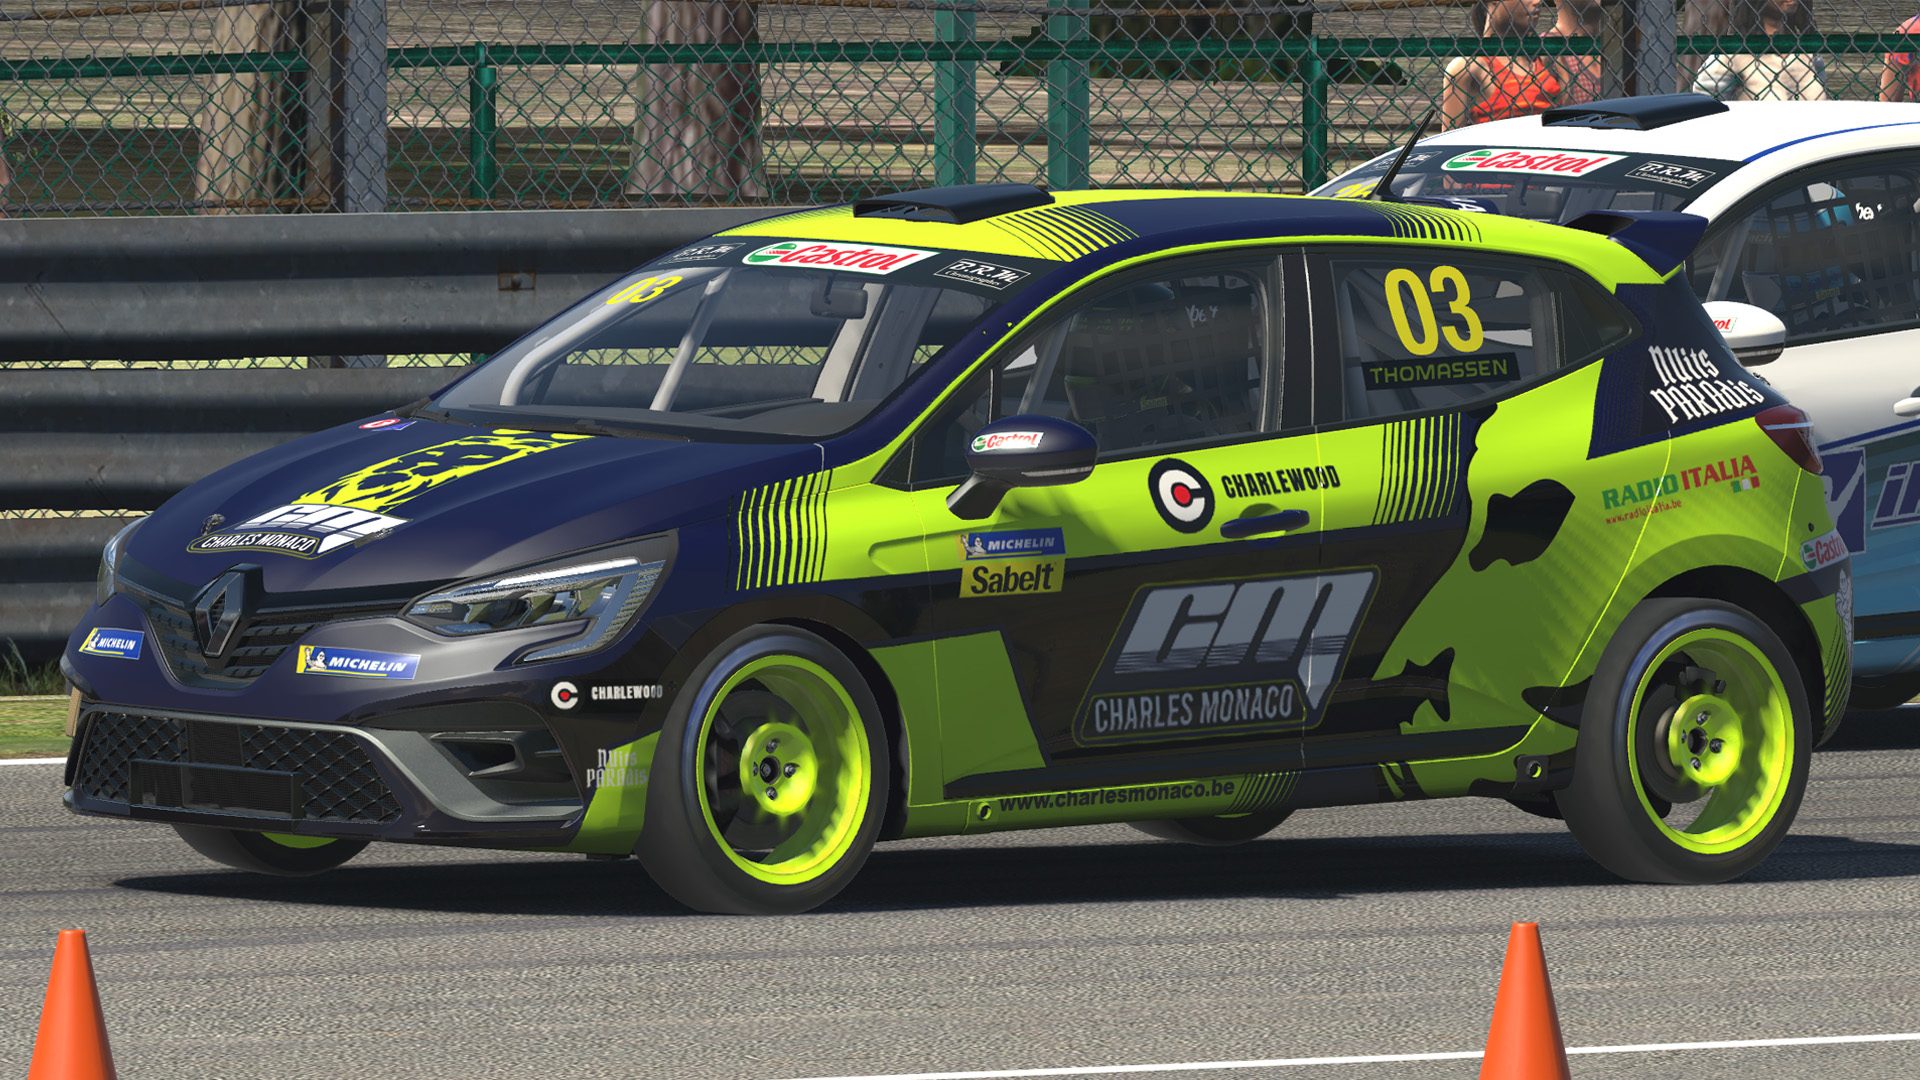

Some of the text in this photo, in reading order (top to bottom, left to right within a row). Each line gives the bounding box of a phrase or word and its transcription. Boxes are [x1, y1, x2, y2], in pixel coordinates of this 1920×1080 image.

[1477, 151, 1609, 173] Castrol
[779, 244, 918, 270] Castrol
[606, 275, 683, 305] 03
[1385, 265, 1484, 356] 03
[1369, 359, 1508, 384] THOMASSEN
[987, 433, 1039, 449] Castrol
[1221, 465, 1341, 499] CHARLEWOOD
[1602, 454, 1758, 510] RADIO ITALIA
[201, 533, 316, 552] CHARLES MONACO
[987, 537, 1056, 551] MICHELIN
[971, 562, 1053, 595] Sabelt
[97, 637, 137, 651] MICHELIN
[329, 657, 407, 672] MICHELIN
[591, 685, 663, 700] CHARLEWOOD
[1094, 684, 1295, 734] CHARLES MONACO
[1000, 778, 1236, 812] www.charlesmonaco.be
